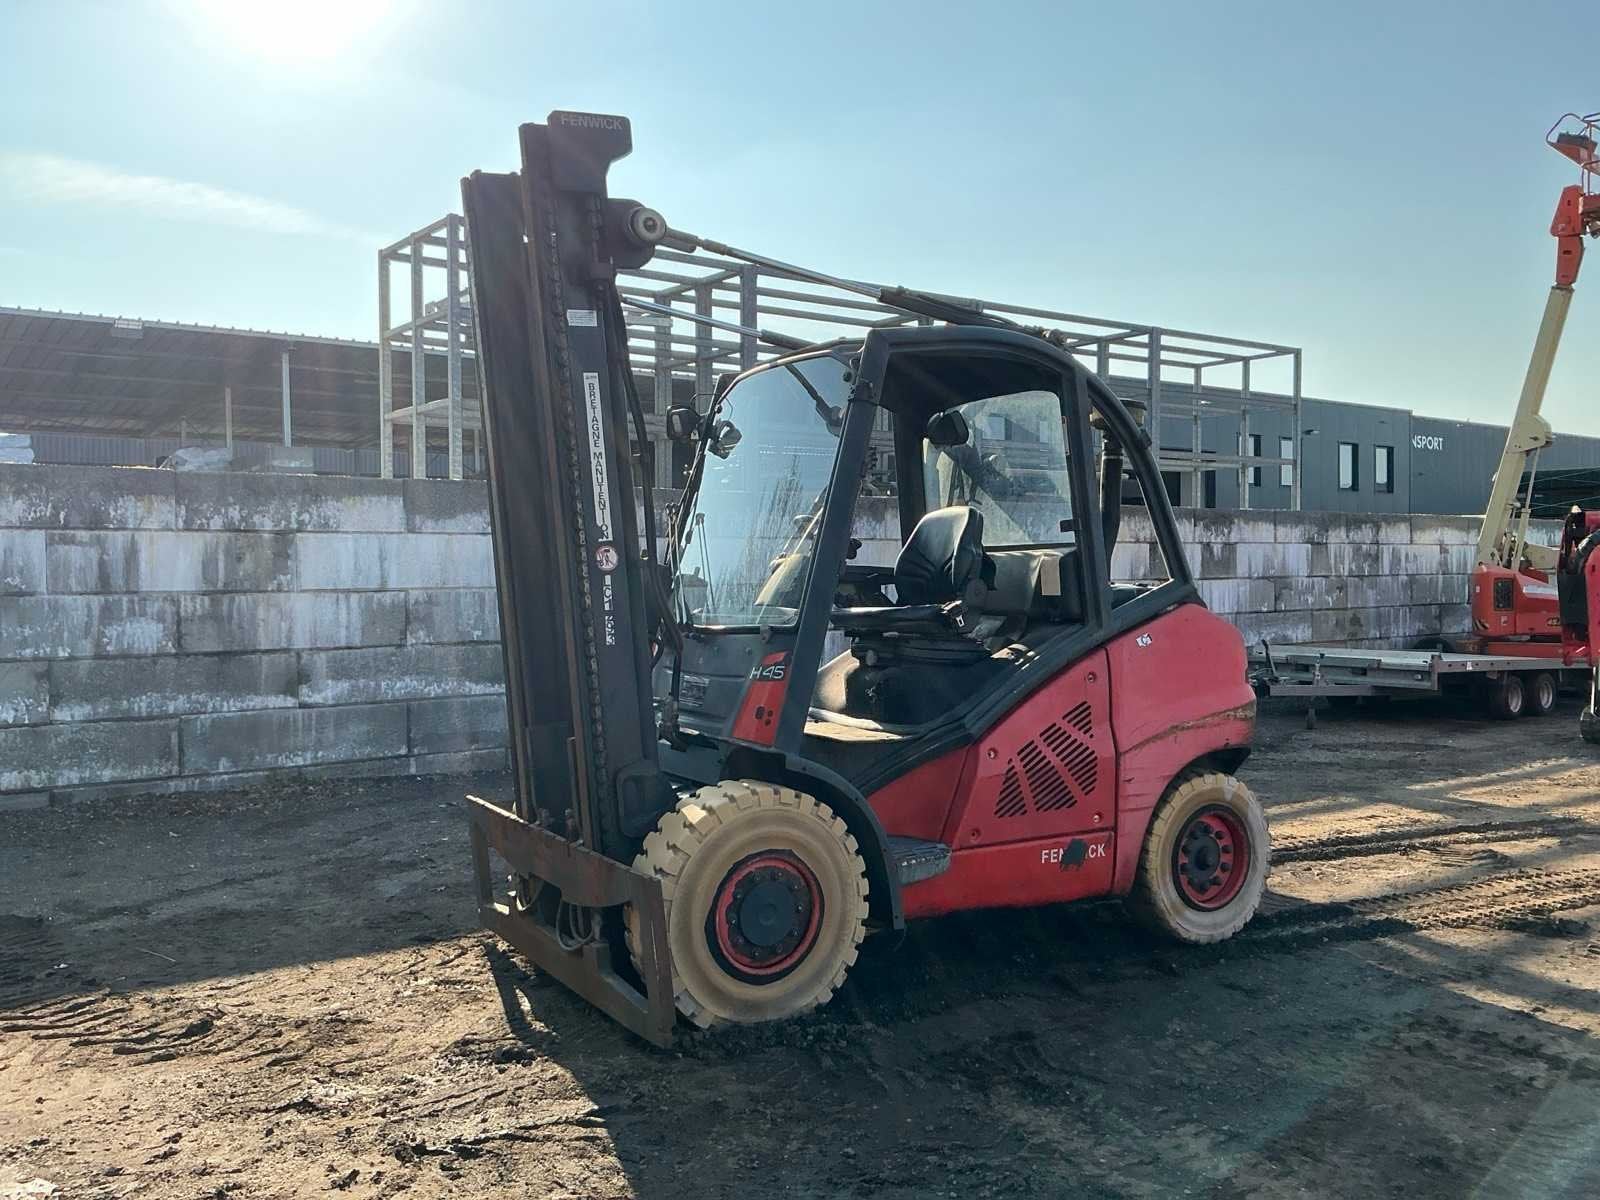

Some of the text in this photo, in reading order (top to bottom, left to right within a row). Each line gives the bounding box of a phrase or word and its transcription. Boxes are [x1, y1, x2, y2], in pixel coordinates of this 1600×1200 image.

[561, 113, 623, 130] FENWICK
[588, 382, 601, 447] BRETAGNE
[593, 451, 609, 540] MANUTENTION
